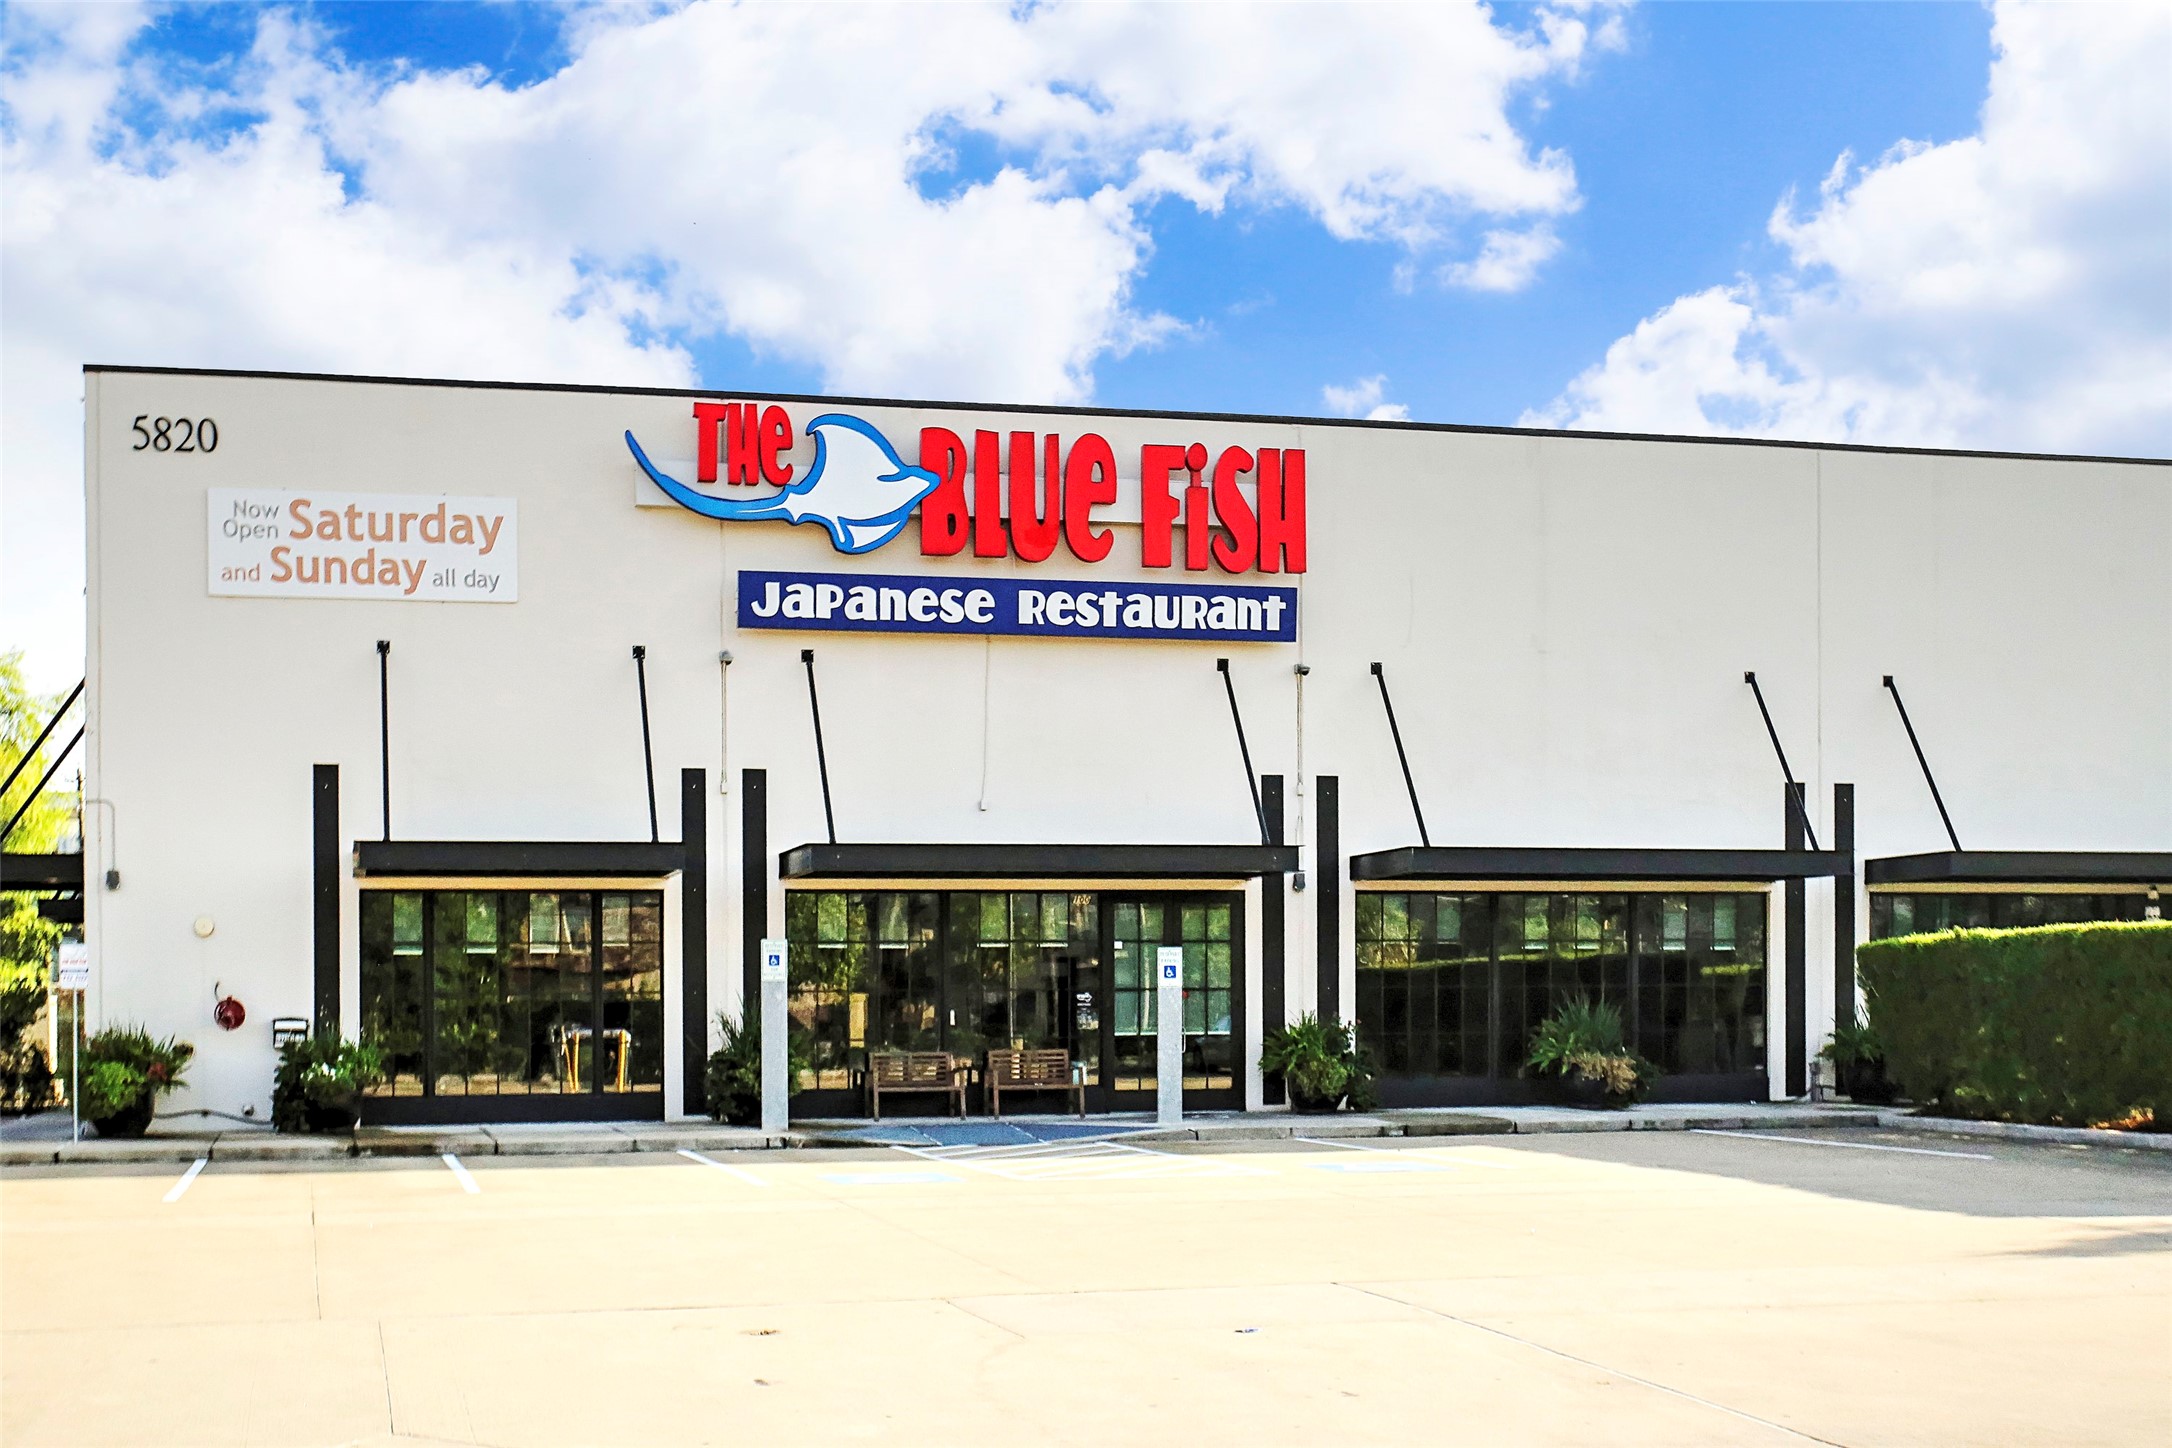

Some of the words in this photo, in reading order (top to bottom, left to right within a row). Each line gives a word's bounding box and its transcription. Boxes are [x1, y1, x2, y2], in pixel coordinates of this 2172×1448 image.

[132, 413, 218, 453] 5820
[233, 499, 279, 520] Now
[288, 498, 504, 556] Saturday
[222, 519, 279, 543] Open
[220, 563, 260, 583] and
[270, 546, 427, 596] Sunday
[432, 567, 456, 588] all
[464, 569, 501, 594] day
